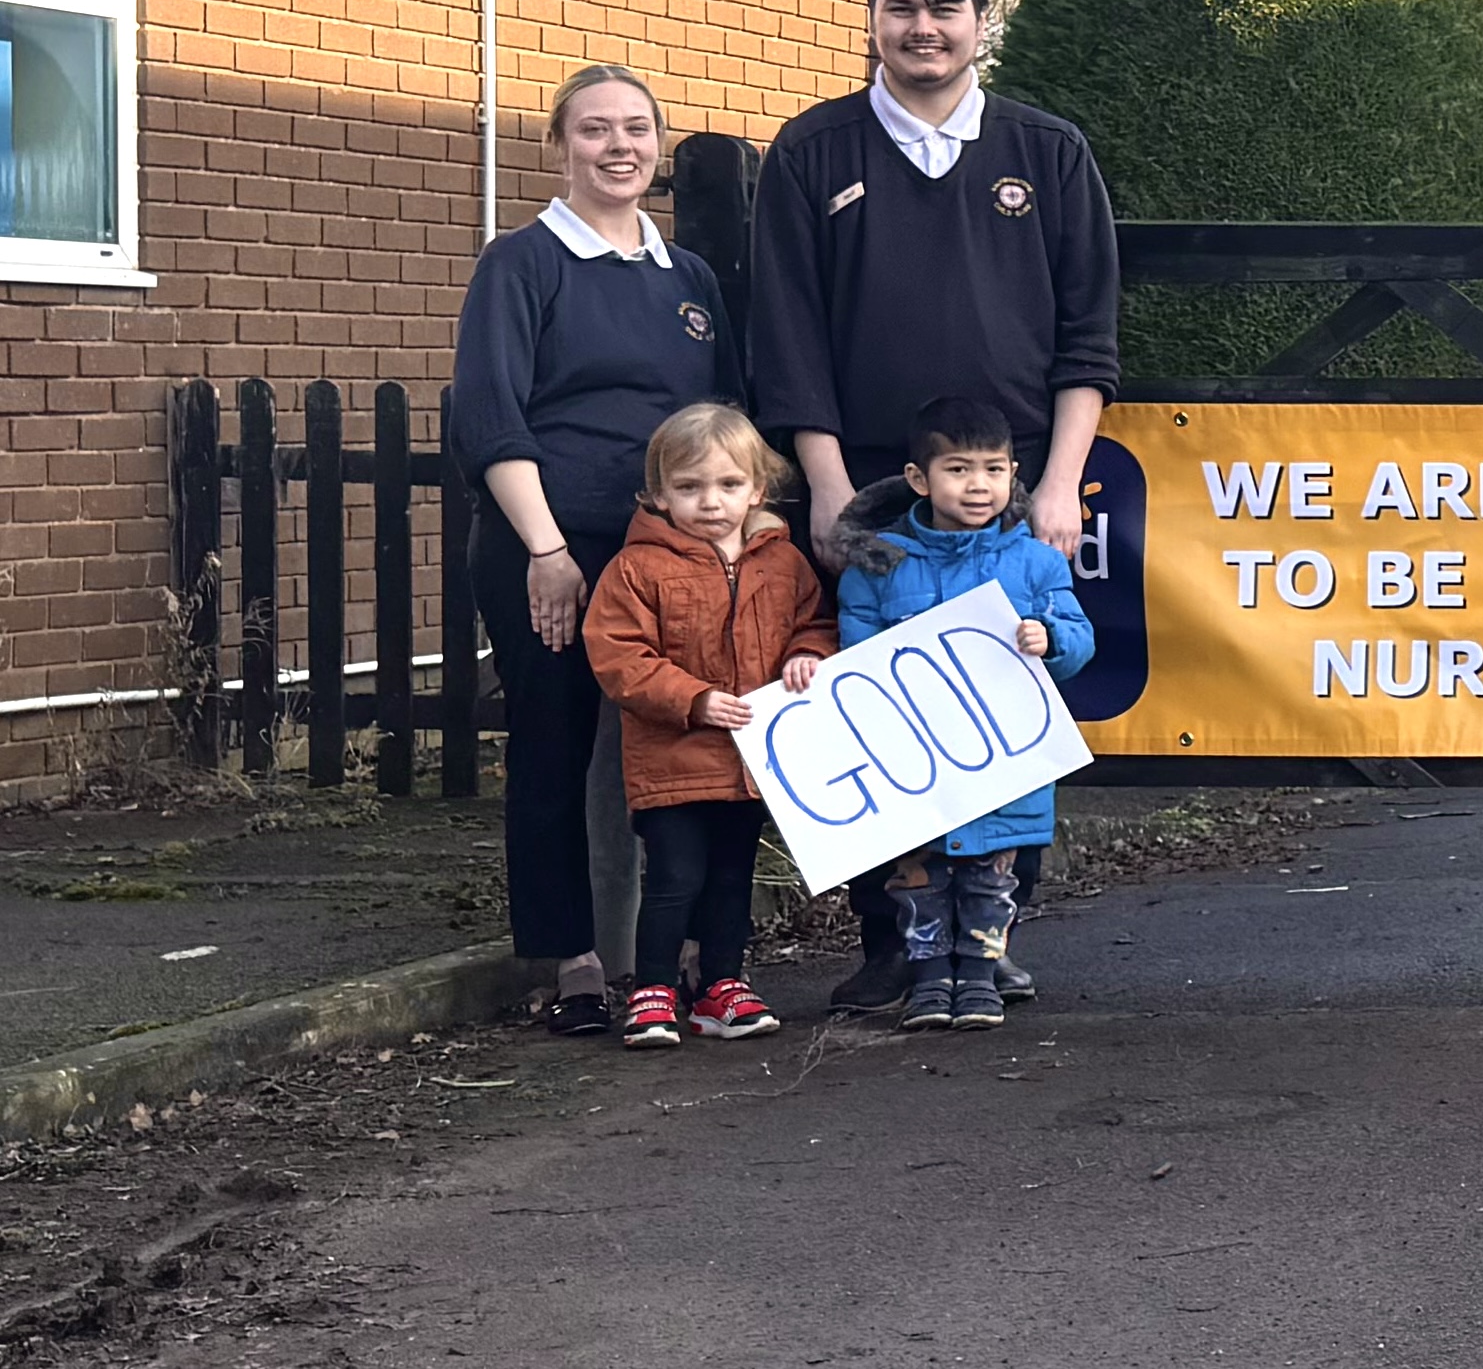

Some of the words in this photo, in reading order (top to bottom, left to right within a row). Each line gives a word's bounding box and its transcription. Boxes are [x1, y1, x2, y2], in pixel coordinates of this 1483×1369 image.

[1202, 461, 1335, 519] WE
[1223, 549, 1336, 609] TO
[1366, 550, 1467, 609] BE
[765, 626, 1052, 827] GOOD
